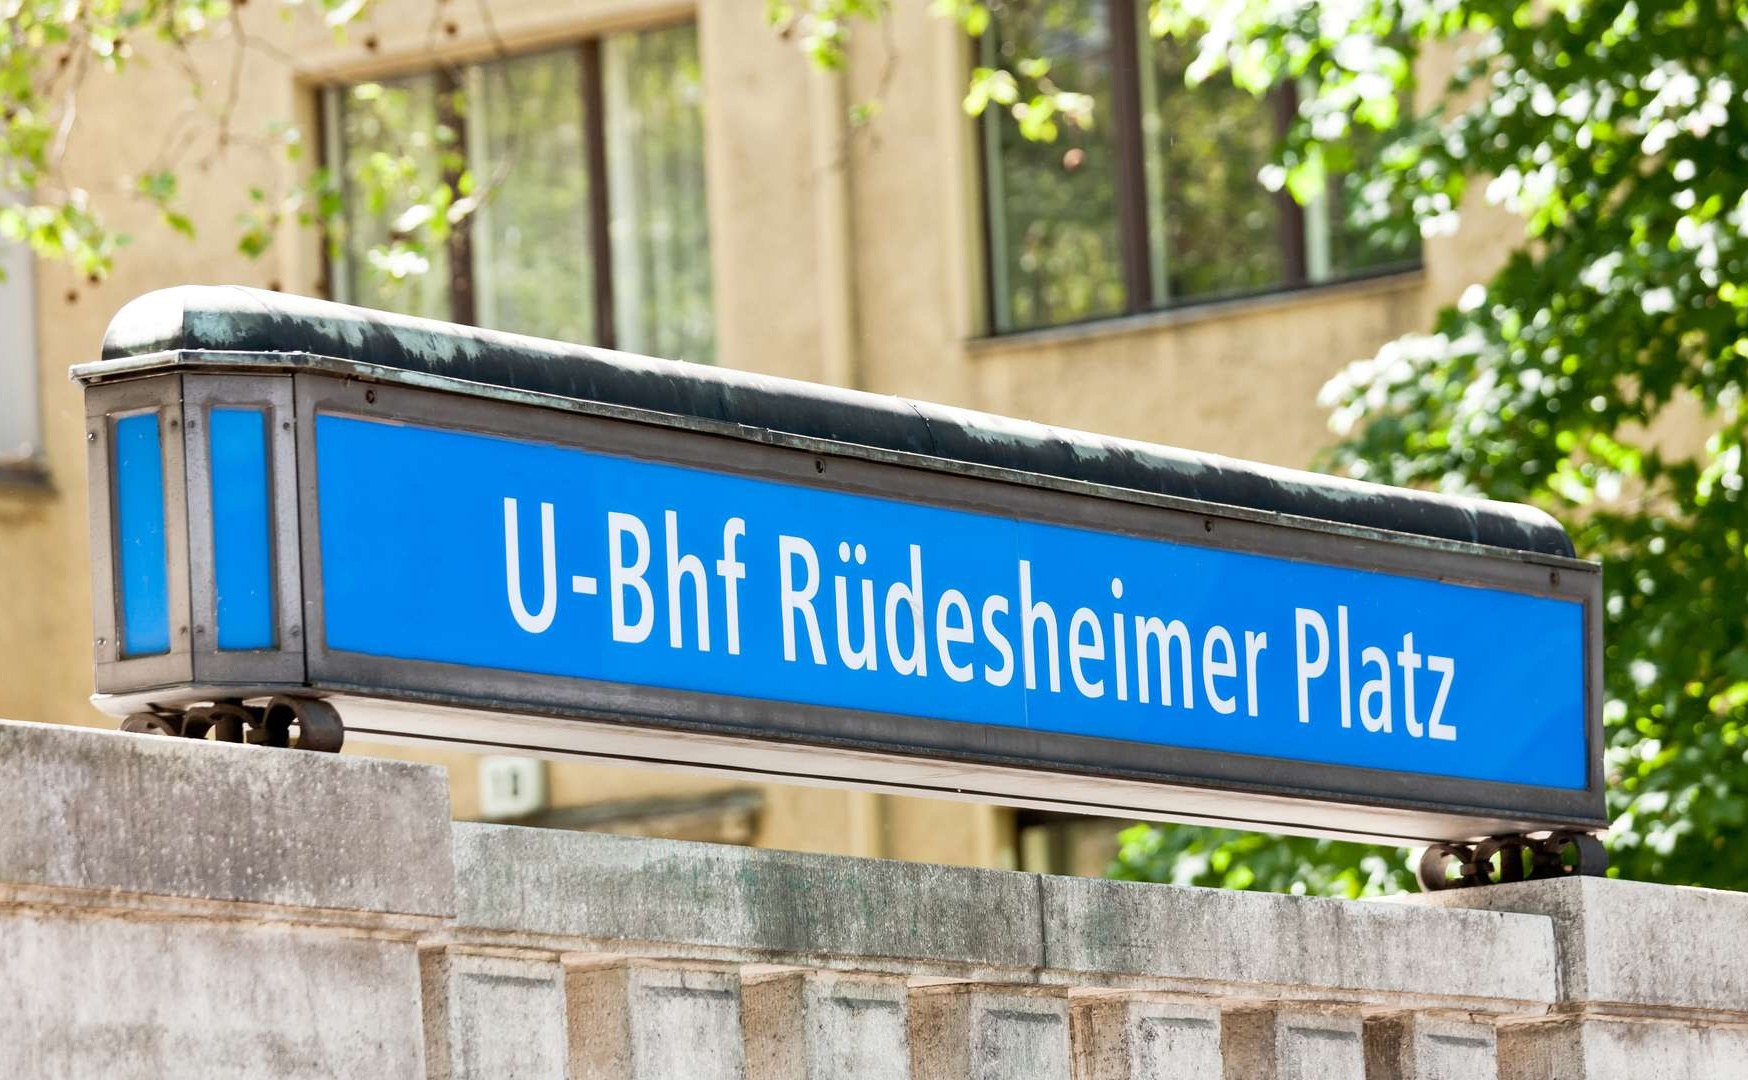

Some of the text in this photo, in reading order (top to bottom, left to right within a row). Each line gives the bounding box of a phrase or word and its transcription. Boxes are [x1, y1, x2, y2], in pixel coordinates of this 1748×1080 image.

[503, 497, 1457, 741] U-Bhf Rüdesheimer Platz
